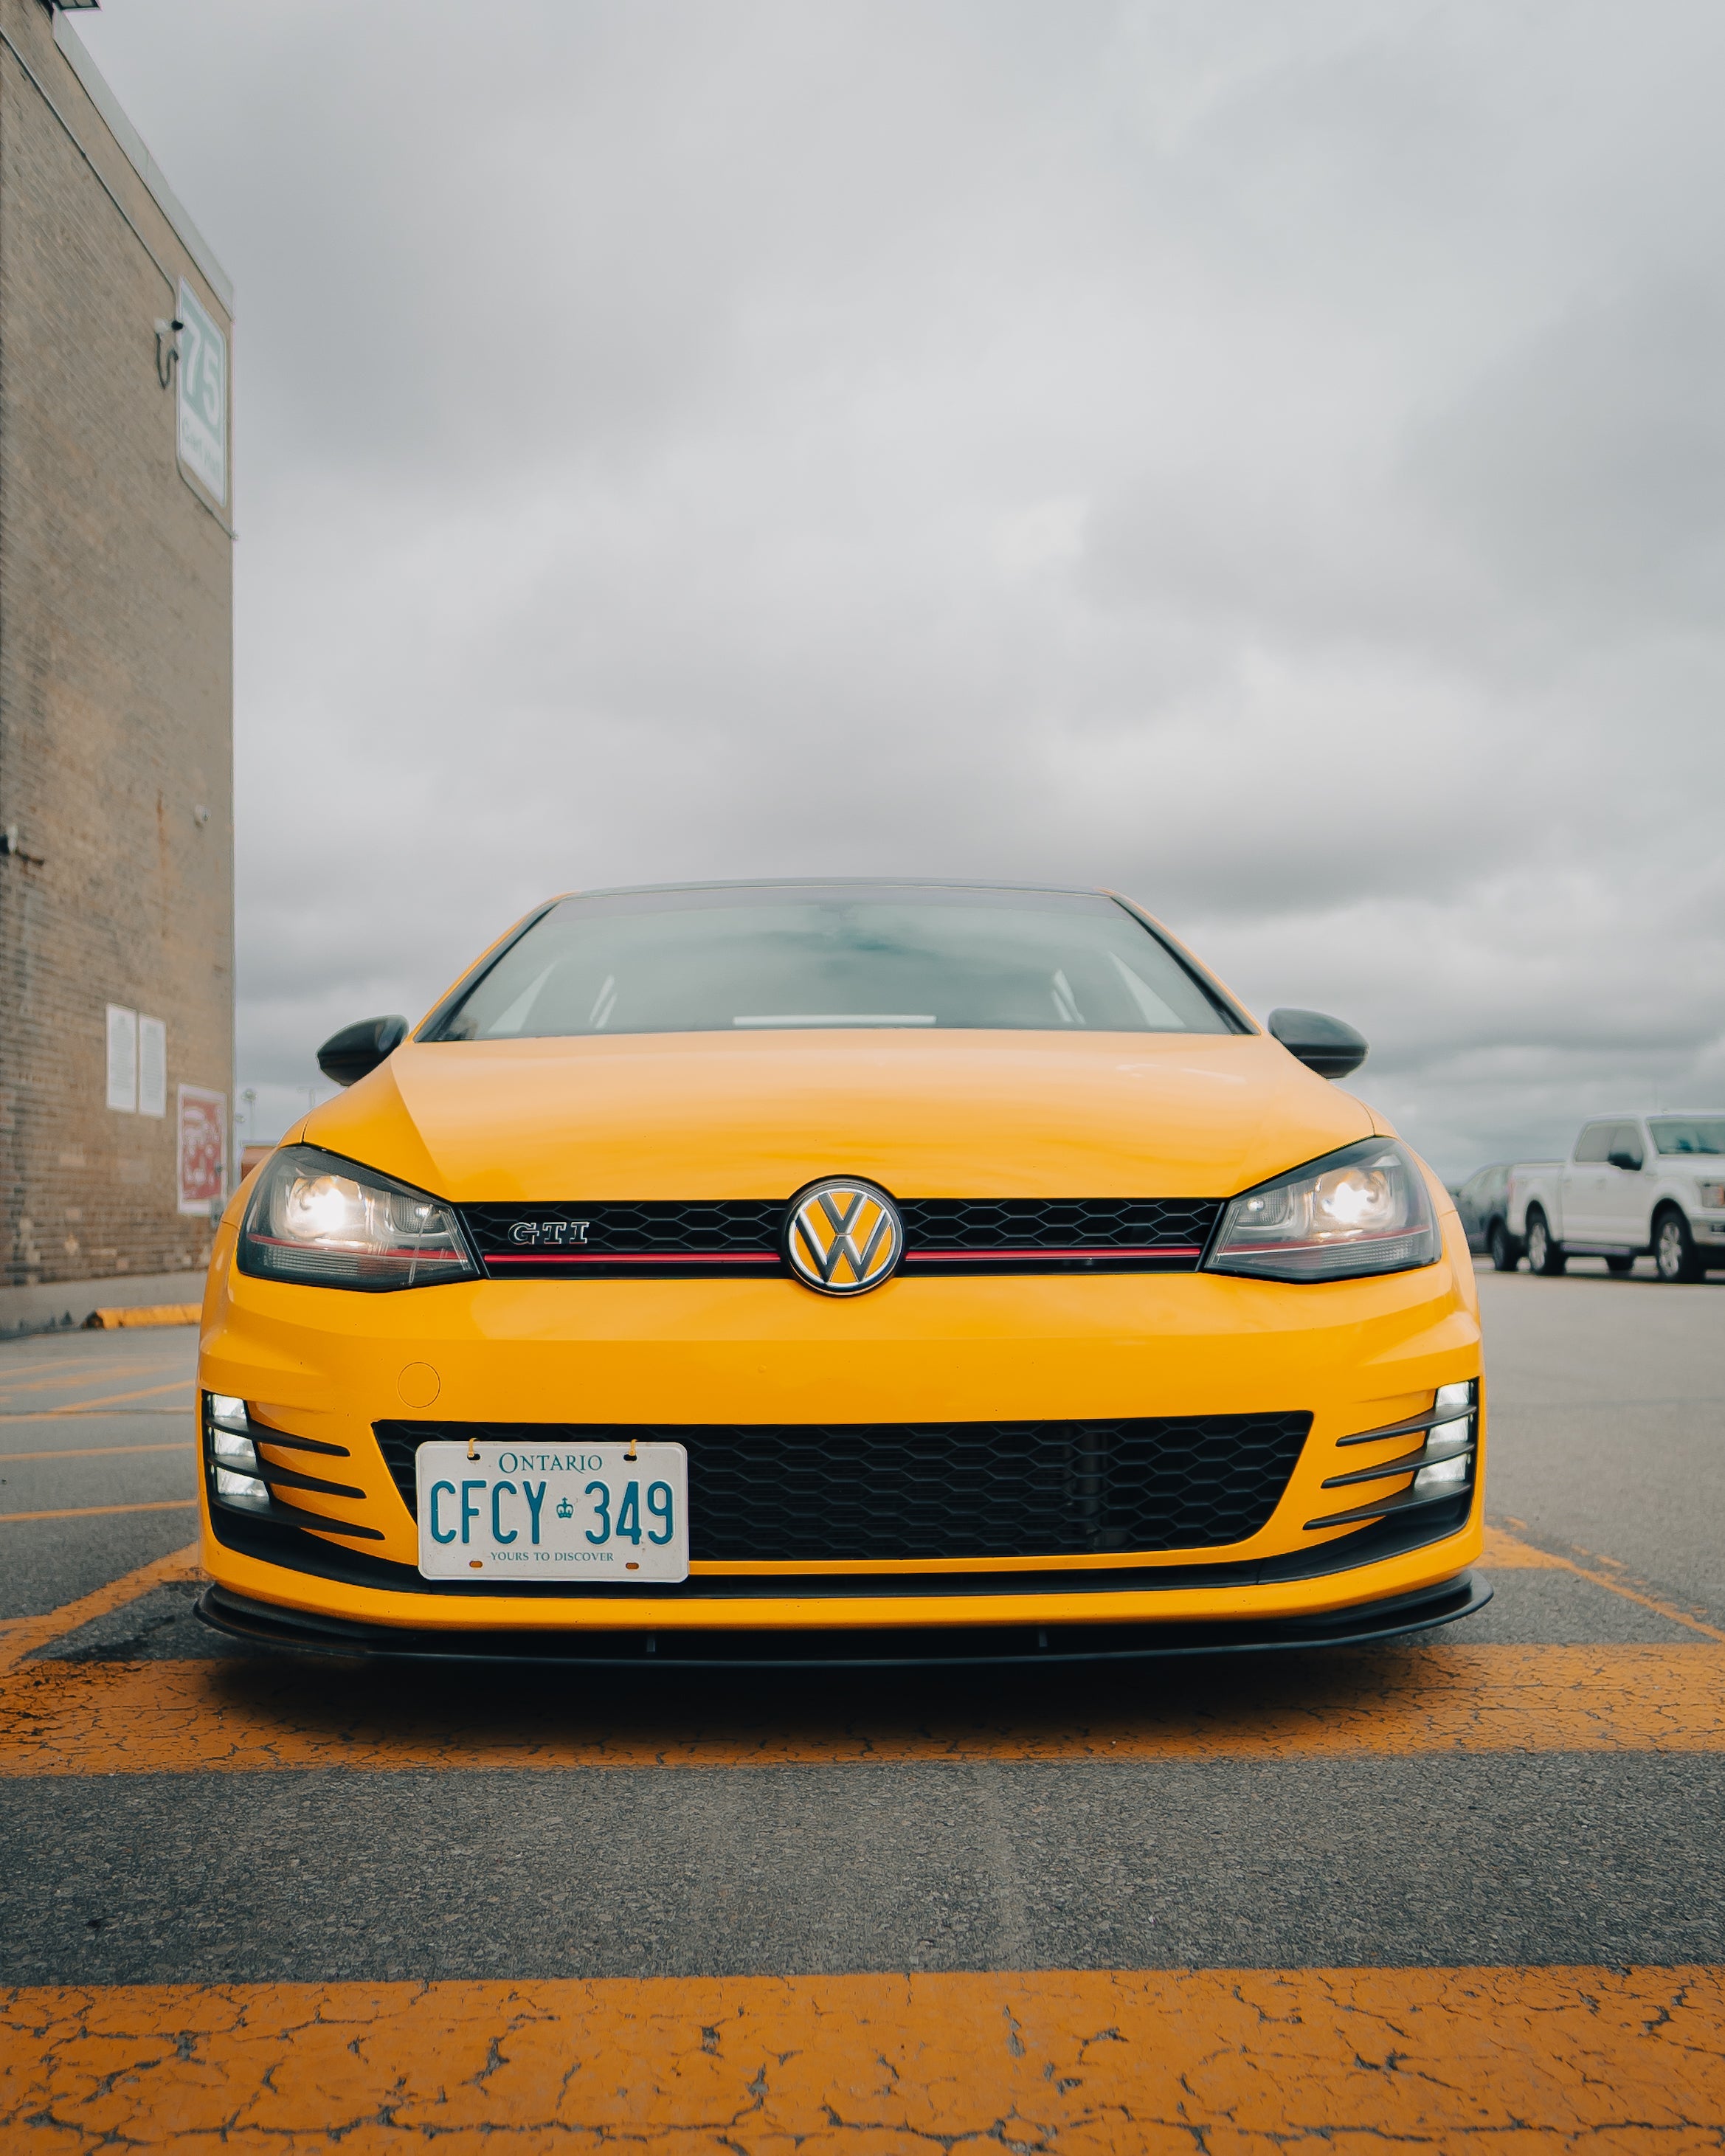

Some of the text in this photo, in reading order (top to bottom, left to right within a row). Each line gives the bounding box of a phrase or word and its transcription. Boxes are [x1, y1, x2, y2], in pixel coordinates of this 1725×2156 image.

[183, 307, 221, 426] 75
[508, 1221, 590, 1245] GTI
[499, 1452, 603, 1473] ONTARIO
[430, 1480, 674, 1545] CFCY 349
[491, 1552, 614, 1561] YOURS TO DISCOVER
